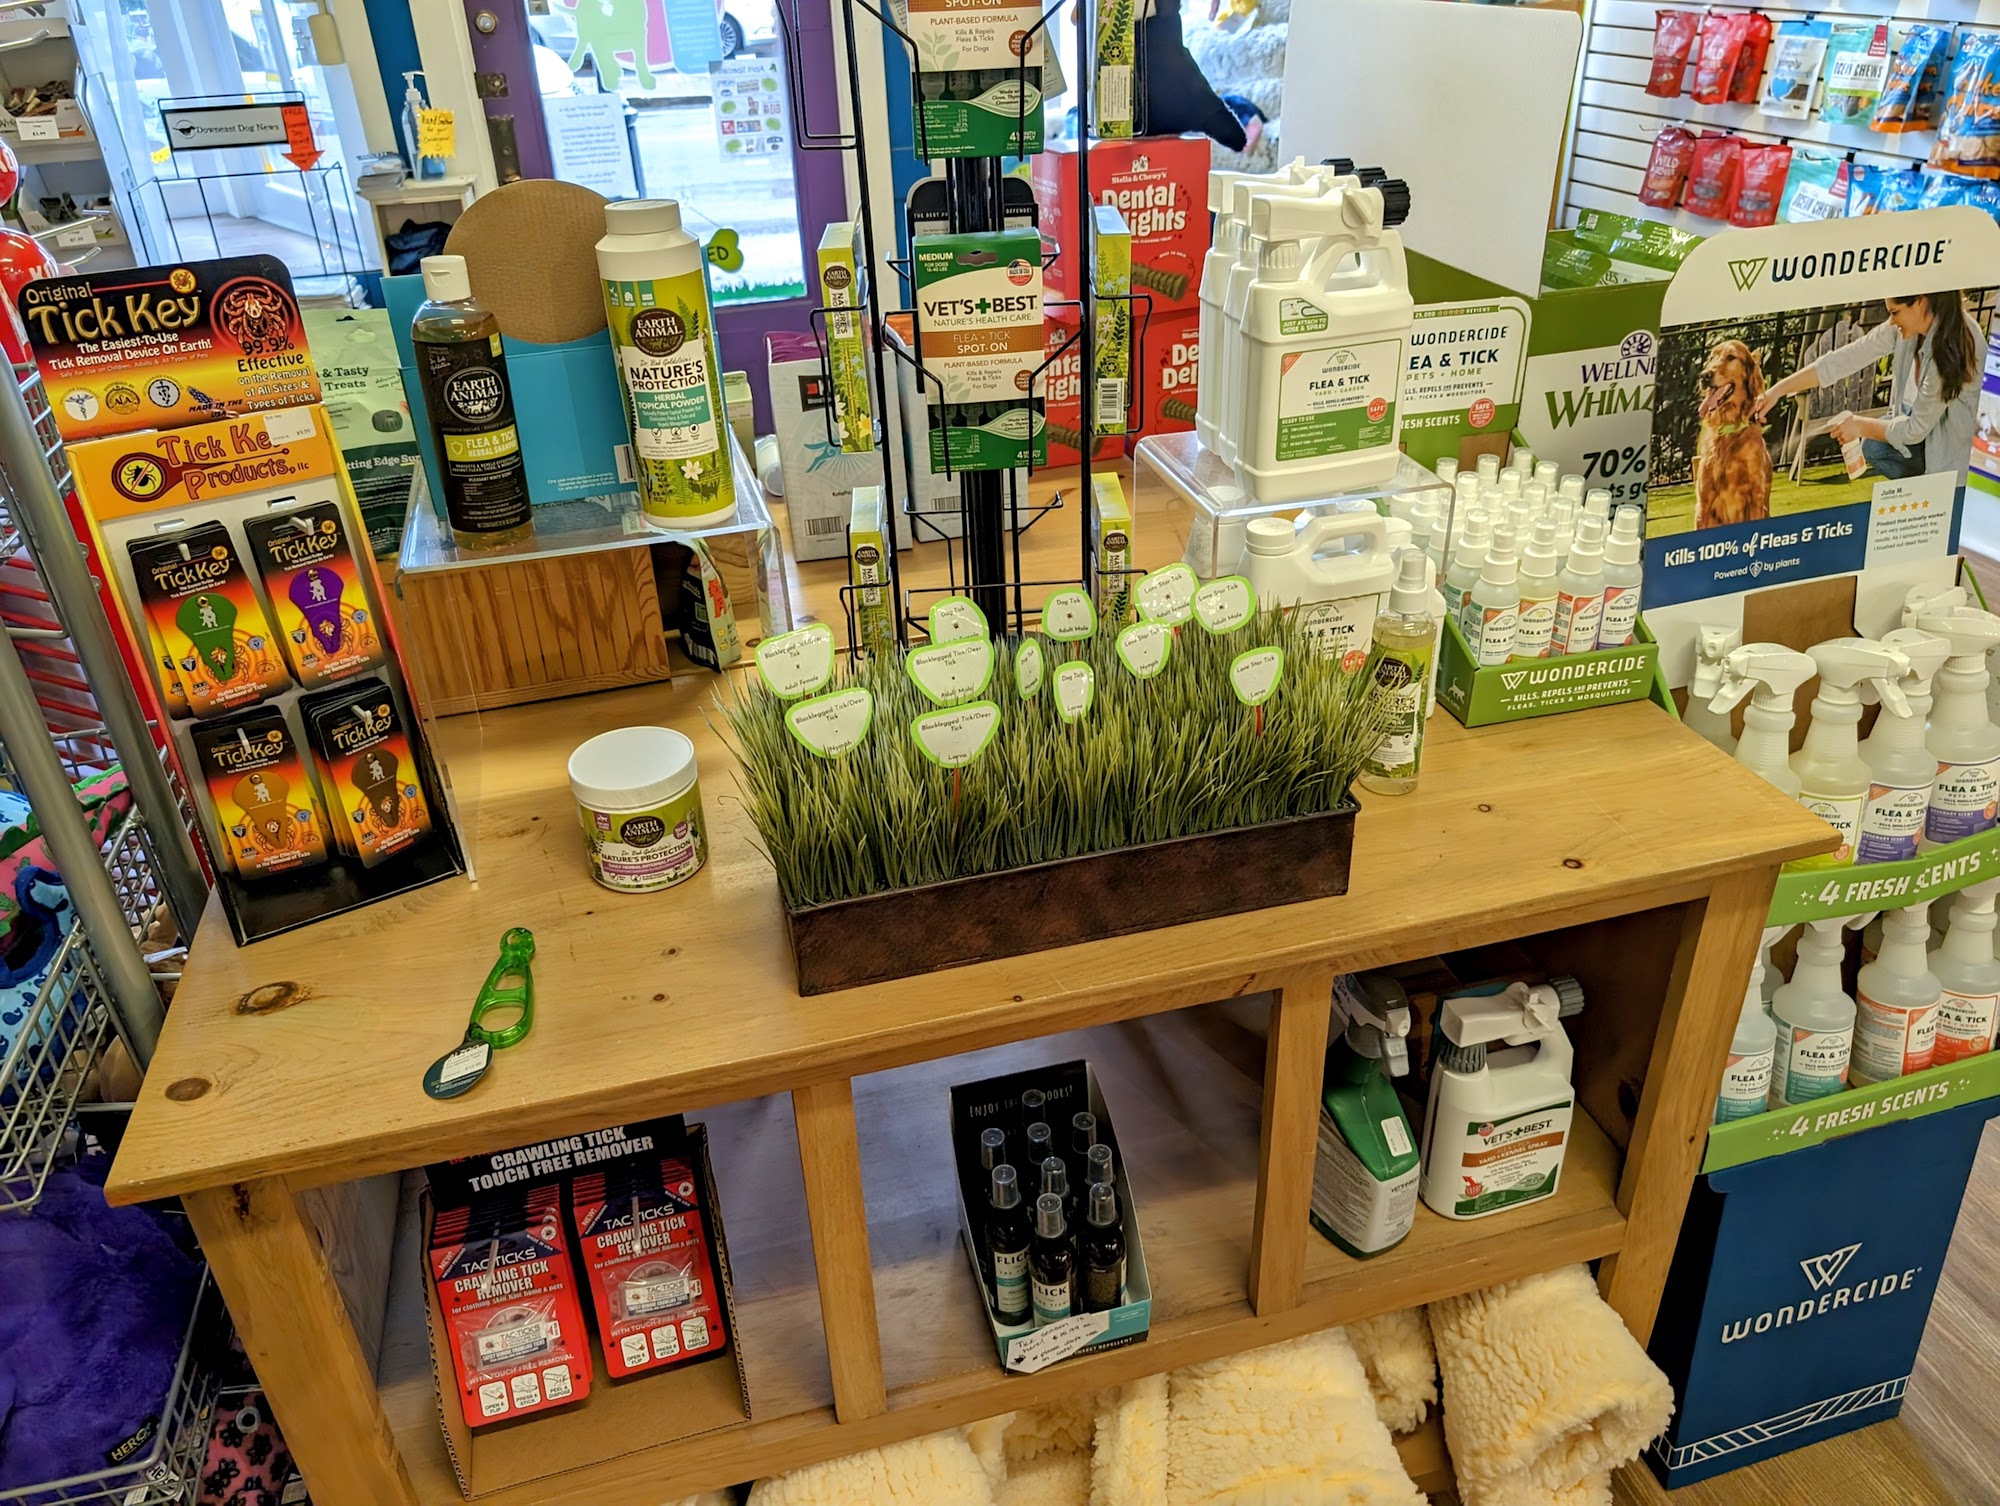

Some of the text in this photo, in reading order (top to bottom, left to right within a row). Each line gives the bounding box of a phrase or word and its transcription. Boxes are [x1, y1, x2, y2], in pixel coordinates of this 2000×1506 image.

[982, 15, 1018, 23] FORMULA
[238, 124, 254, 132] Dog
[257, 123, 279, 131] News
[1112, 176, 1132, 185] Stella
[1102, 182, 1176, 211] Dental
[918, 252, 954, 261] MEDIUM
[1770, 240, 1947, 283] WONDERCIDE
[26, 282, 93, 304] Original
[28, 293, 200, 344] Tick Key
[636, 317, 676, 331] EARTH
[933, 313, 1032, 327] NATURE'S HEALTH CARE
[1282, 320, 1296, 328] JUST
[1297, 318, 1318, 327] ATTACH
[1306, 322, 1327, 331] SPRAY
[635, 326, 681, 340] ANIMAL
[953, 333, 979, 343] FLEA
[988, 331, 1011, 340] TICK
[1410, 326, 1509, 346] WONDERCIDE
[78, 332, 179, 354] The Easiest-To-Use
[242, 336, 295, 355] 99.9%
[957, 342, 1008, 353] SPOT-ON
[49, 339, 212, 371] Tick Removal Device On Earth!
[237, 353, 305, 373] Effective
[944, 360, 989, 368] PLANT-BASED
[1407, 348, 1499, 371] EA & TICK
[238, 366, 310, 385] on the Removal
[333, 365, 369, 379] Tasty
[630, 360, 703, 380] NATURE'S
[1322, 363, 1361, 374] WONDERCIDE
[1406, 367, 1482, 381] PETS HOME
[1582, 357, 1656, 384] WELLNE
[245, 380, 309, 398] of All Sizes &
[325, 379, 366, 391] Treats
[452, 376, 496, 393] EARTH
[632, 373, 705, 391] PROTECTION
[1309, 374, 1370, 391] FLEA & TICK
[1419, 381, 1484, 394] REPELS PREVENTS
[450, 384, 501, 401] ANIMAL
[654, 392, 687, 402] HERBAL
[247, 393, 316, 411] Types of Ticks
[637, 395, 705, 411] TOPICAL POWDER
[1401, 414, 1460, 430] RESH SCENTS
[156, 423, 279, 467] Tick Ke
[466, 430, 516, 449] FLEA & TICK
[1583, 444, 1647, 480] 70%
[184, 455, 296, 501] Products,
[1664, 521, 1853, 568] Kills 100% of Fleas & Ticks
[152, 563, 178, 575] Original
[1714, 555, 1800, 581] Powered by plants
[916, 646, 982, 666] Blacklegged Tick/Deer
[1529, 656, 1646, 685] WONDERCIDE
[1507, 702, 1537, 711] FLEAS,
[1541, 697, 1565, 706] TICKS
[1577, 688, 1631, 701] MOSQUITOES
[1514, 692, 1539, 702] KILLS,
[1542, 687, 1572, 700] REPELS
[1587, 679, 1628, 692] PREVENTS
[795, 697, 864, 724] Blacklegged Tick/Deer
[921, 712, 991, 731] Blacklegged Tick/Deer
[948, 752, 967, 760] Larva
[1938, 781, 1998, 793] FLEA & TICK
[1875, 808, 1912, 818] FLEA &
[624, 826, 661, 837] ANIMAL
[626, 820, 658, 830] EARTH
[601, 853, 639, 863] NATURE'S
[640, 840, 691, 862] PROTECTION
[1818, 852, 1980, 906] 4 FRESH SCENTS
[1731, 1074, 1755, 1082] FLEA
[969, 1100, 999, 1118] ENJOY
[1790, 1082, 1949, 1137] 4 FRESH SCENTS
[491, 1125, 627, 1172] CRAWLING TICK
[469, 1135, 654, 1193] TOUCH FREE REMOVER
[462, 1248, 537, 1274] TACTICKS
[520, 1261, 549, 1276] TICK
[1034, 1284, 1067, 1298] FLICK
[1721, 1268, 1916, 1344] WONDERCIDE
[1098, 1337, 1133, 1350] REPELLENT
